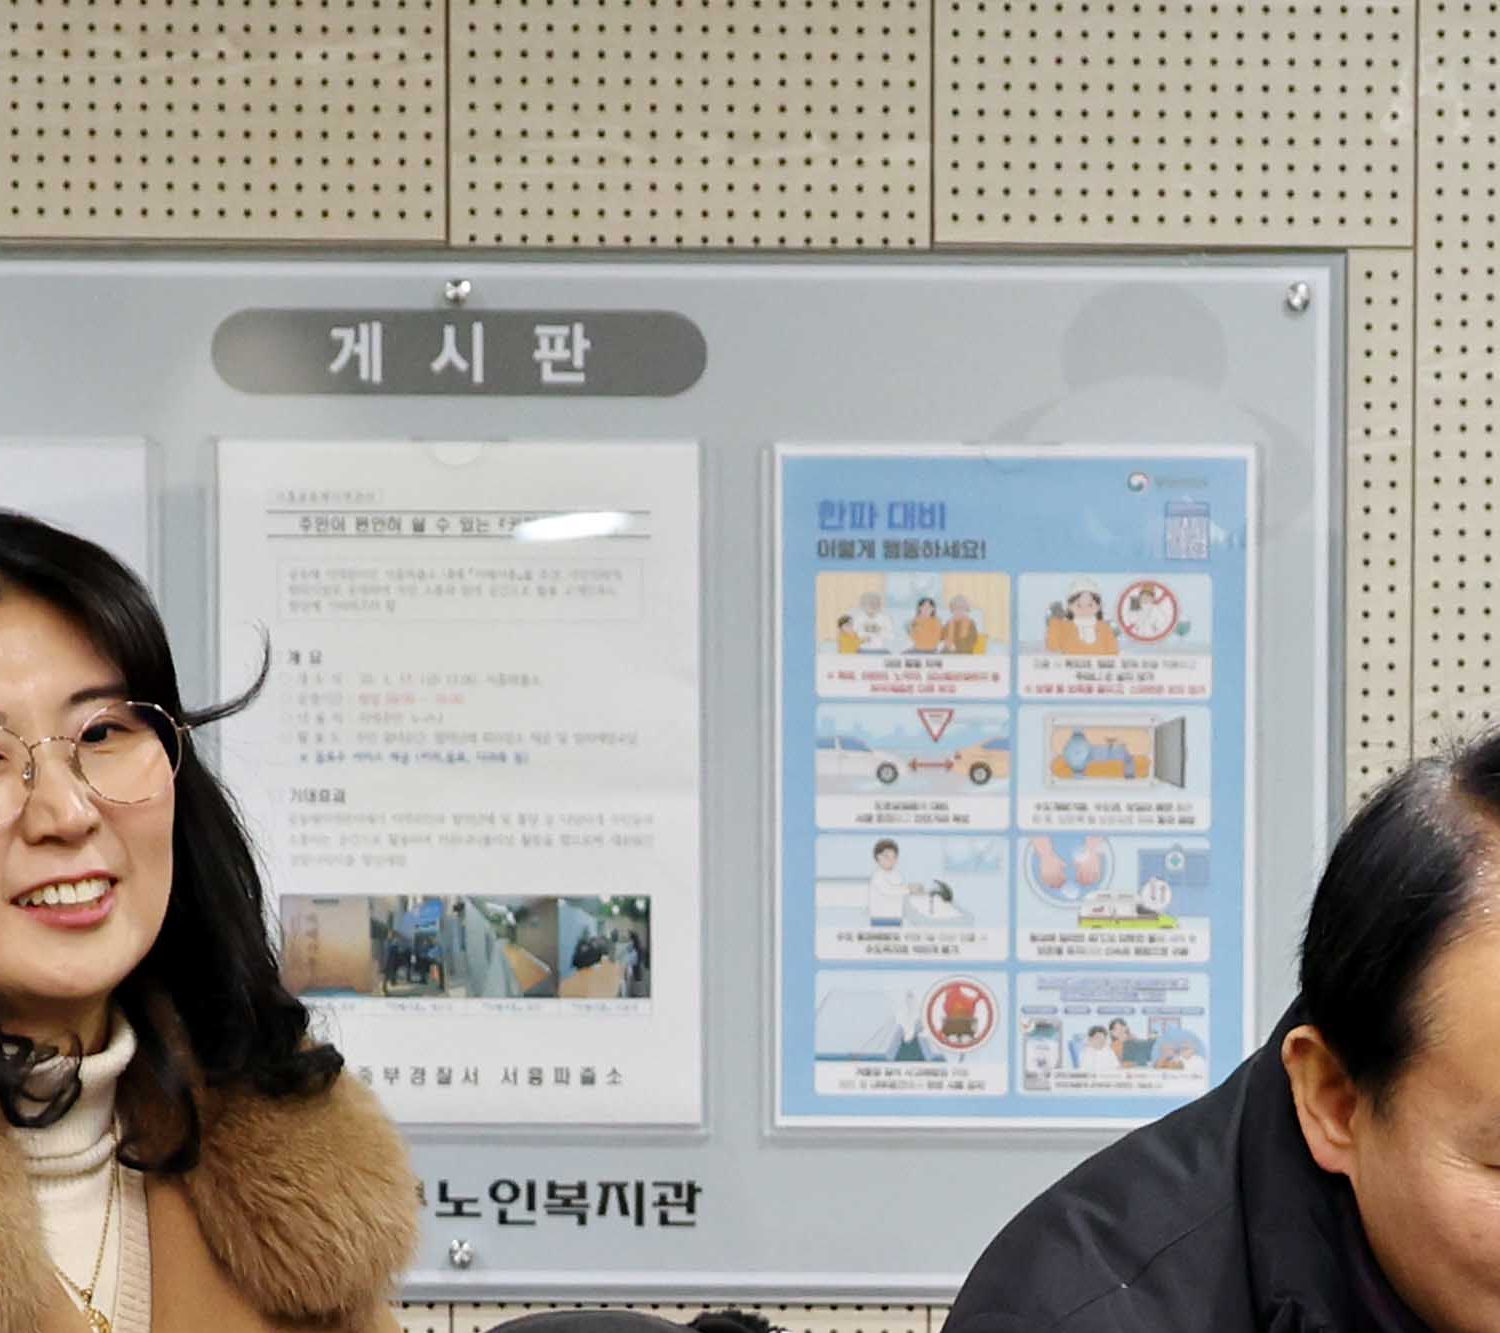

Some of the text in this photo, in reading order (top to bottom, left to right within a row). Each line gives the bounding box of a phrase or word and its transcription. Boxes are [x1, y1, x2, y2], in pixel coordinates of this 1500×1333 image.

[329, 320, 592, 385] 게시판
[435, 515, 451, 534] 수
[459, 515, 490, 533] 있는
[818, 499, 947, 531] 한파 대비
[816, 538, 987, 560] 이렇게 행동하세요!
[416, 1178, 703, 1227] 노인복지관
